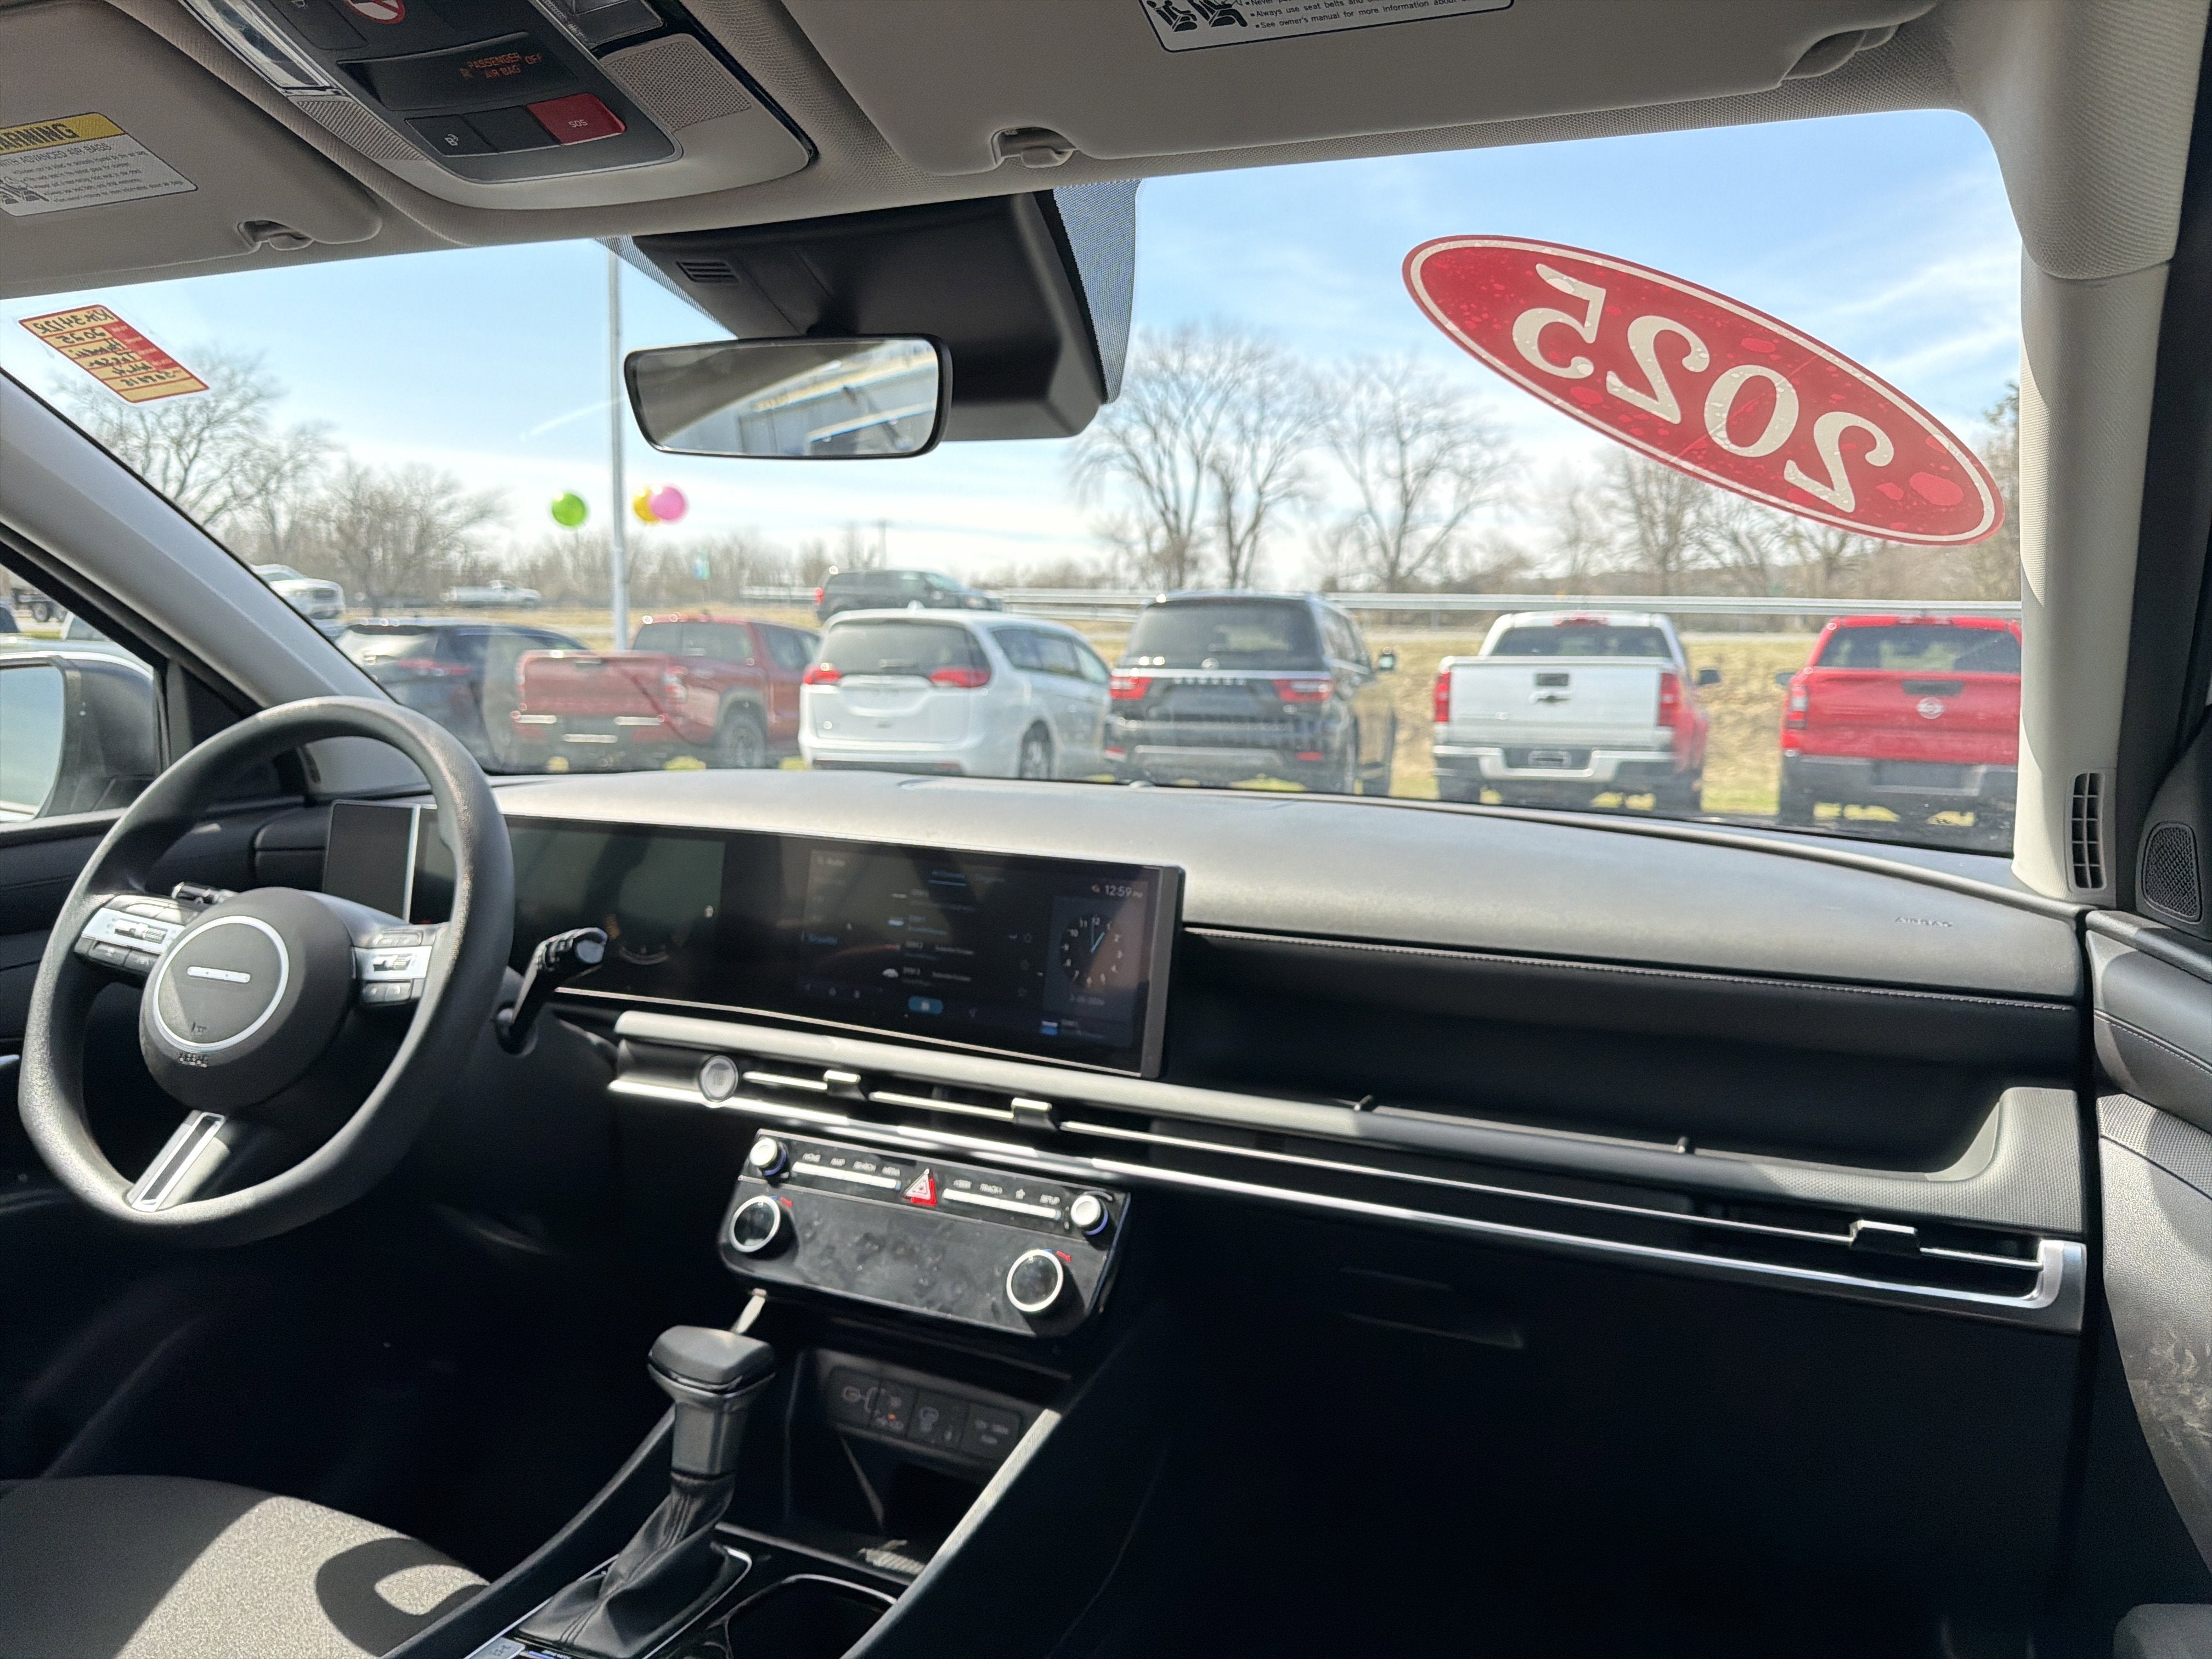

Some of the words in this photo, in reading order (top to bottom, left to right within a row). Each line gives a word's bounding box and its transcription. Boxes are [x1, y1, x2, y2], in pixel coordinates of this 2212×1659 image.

[1257, 9, 1282, 17] Always
[1304, 3, 1321, 11] seat
[1279, 16, 1308, 26] owner's
[1311, 12, 1340, 21] manual
[1358, 7, 1379, 15] more
[1383, 1, 1429, 13] information
[466, 53, 522, 69] PASSENGER
[524, 53, 543, 65] OFF
[485, 69, 500, 79] AIR
[500, 65, 521, 76] BAG
[568, 119, 588, 128] SOS
[0, 122, 80, 150] ARNING
[20, 150, 67, 164] ADVANCED
[84, 143, 112, 153] BAGS
[1039, 1194, 1061, 1205] SETUP
